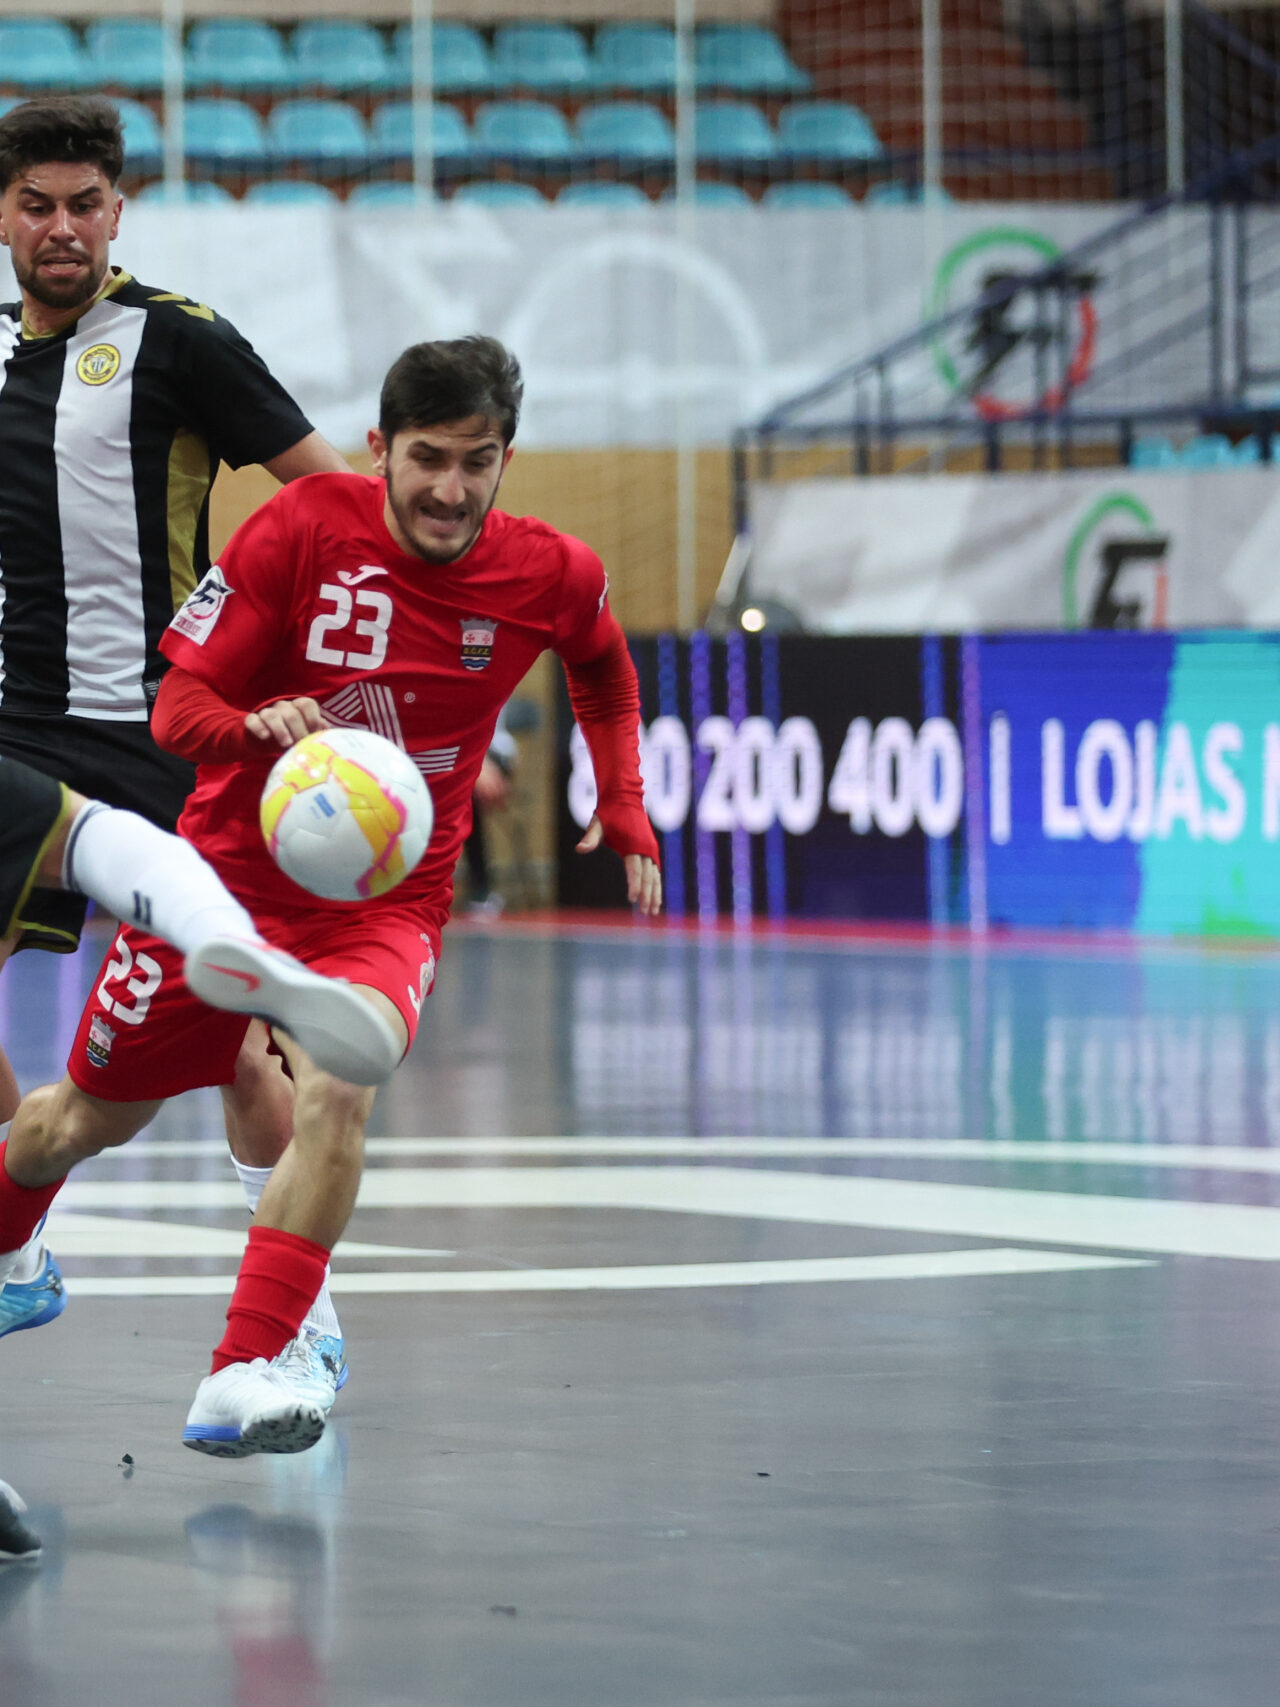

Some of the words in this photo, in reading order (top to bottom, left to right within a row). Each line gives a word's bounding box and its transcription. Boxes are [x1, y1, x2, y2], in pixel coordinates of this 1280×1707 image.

[306, 583, 393, 670] 23
[567, 715, 692, 833] 80
[696, 715, 824, 836] 200
[827, 716, 963, 838] 400
[1040, 718, 1246, 844] LOJAS
[96, 932, 163, 1025] 23
